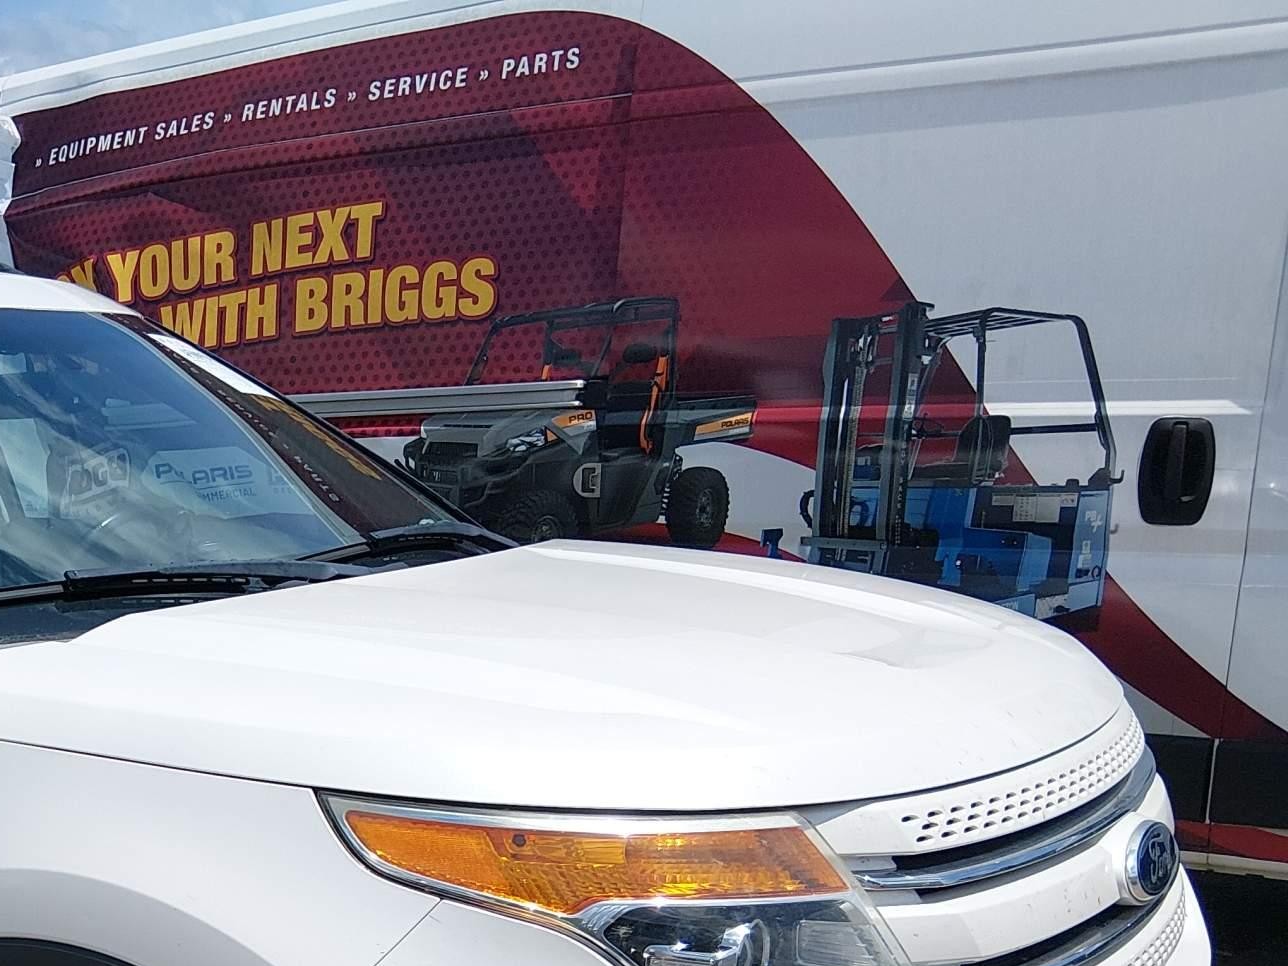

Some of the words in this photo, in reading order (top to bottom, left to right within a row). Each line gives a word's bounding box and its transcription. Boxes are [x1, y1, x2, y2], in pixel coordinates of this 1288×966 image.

[48, 125, 149, 165] EQUIPMENT
[154, 111, 215, 140] SALES
[241, 88, 337, 122] RENTALS
[368, 67, 468, 101] SERVICE
[501, 47, 581, 79] PARTS
[106, 231, 235, 303] YOUR
[250, 201, 383, 276] NEXT
[160, 283, 278, 348] WITH
[295, 258, 497, 334] BRIGGS
[568, 411, 593, 424] PRO
